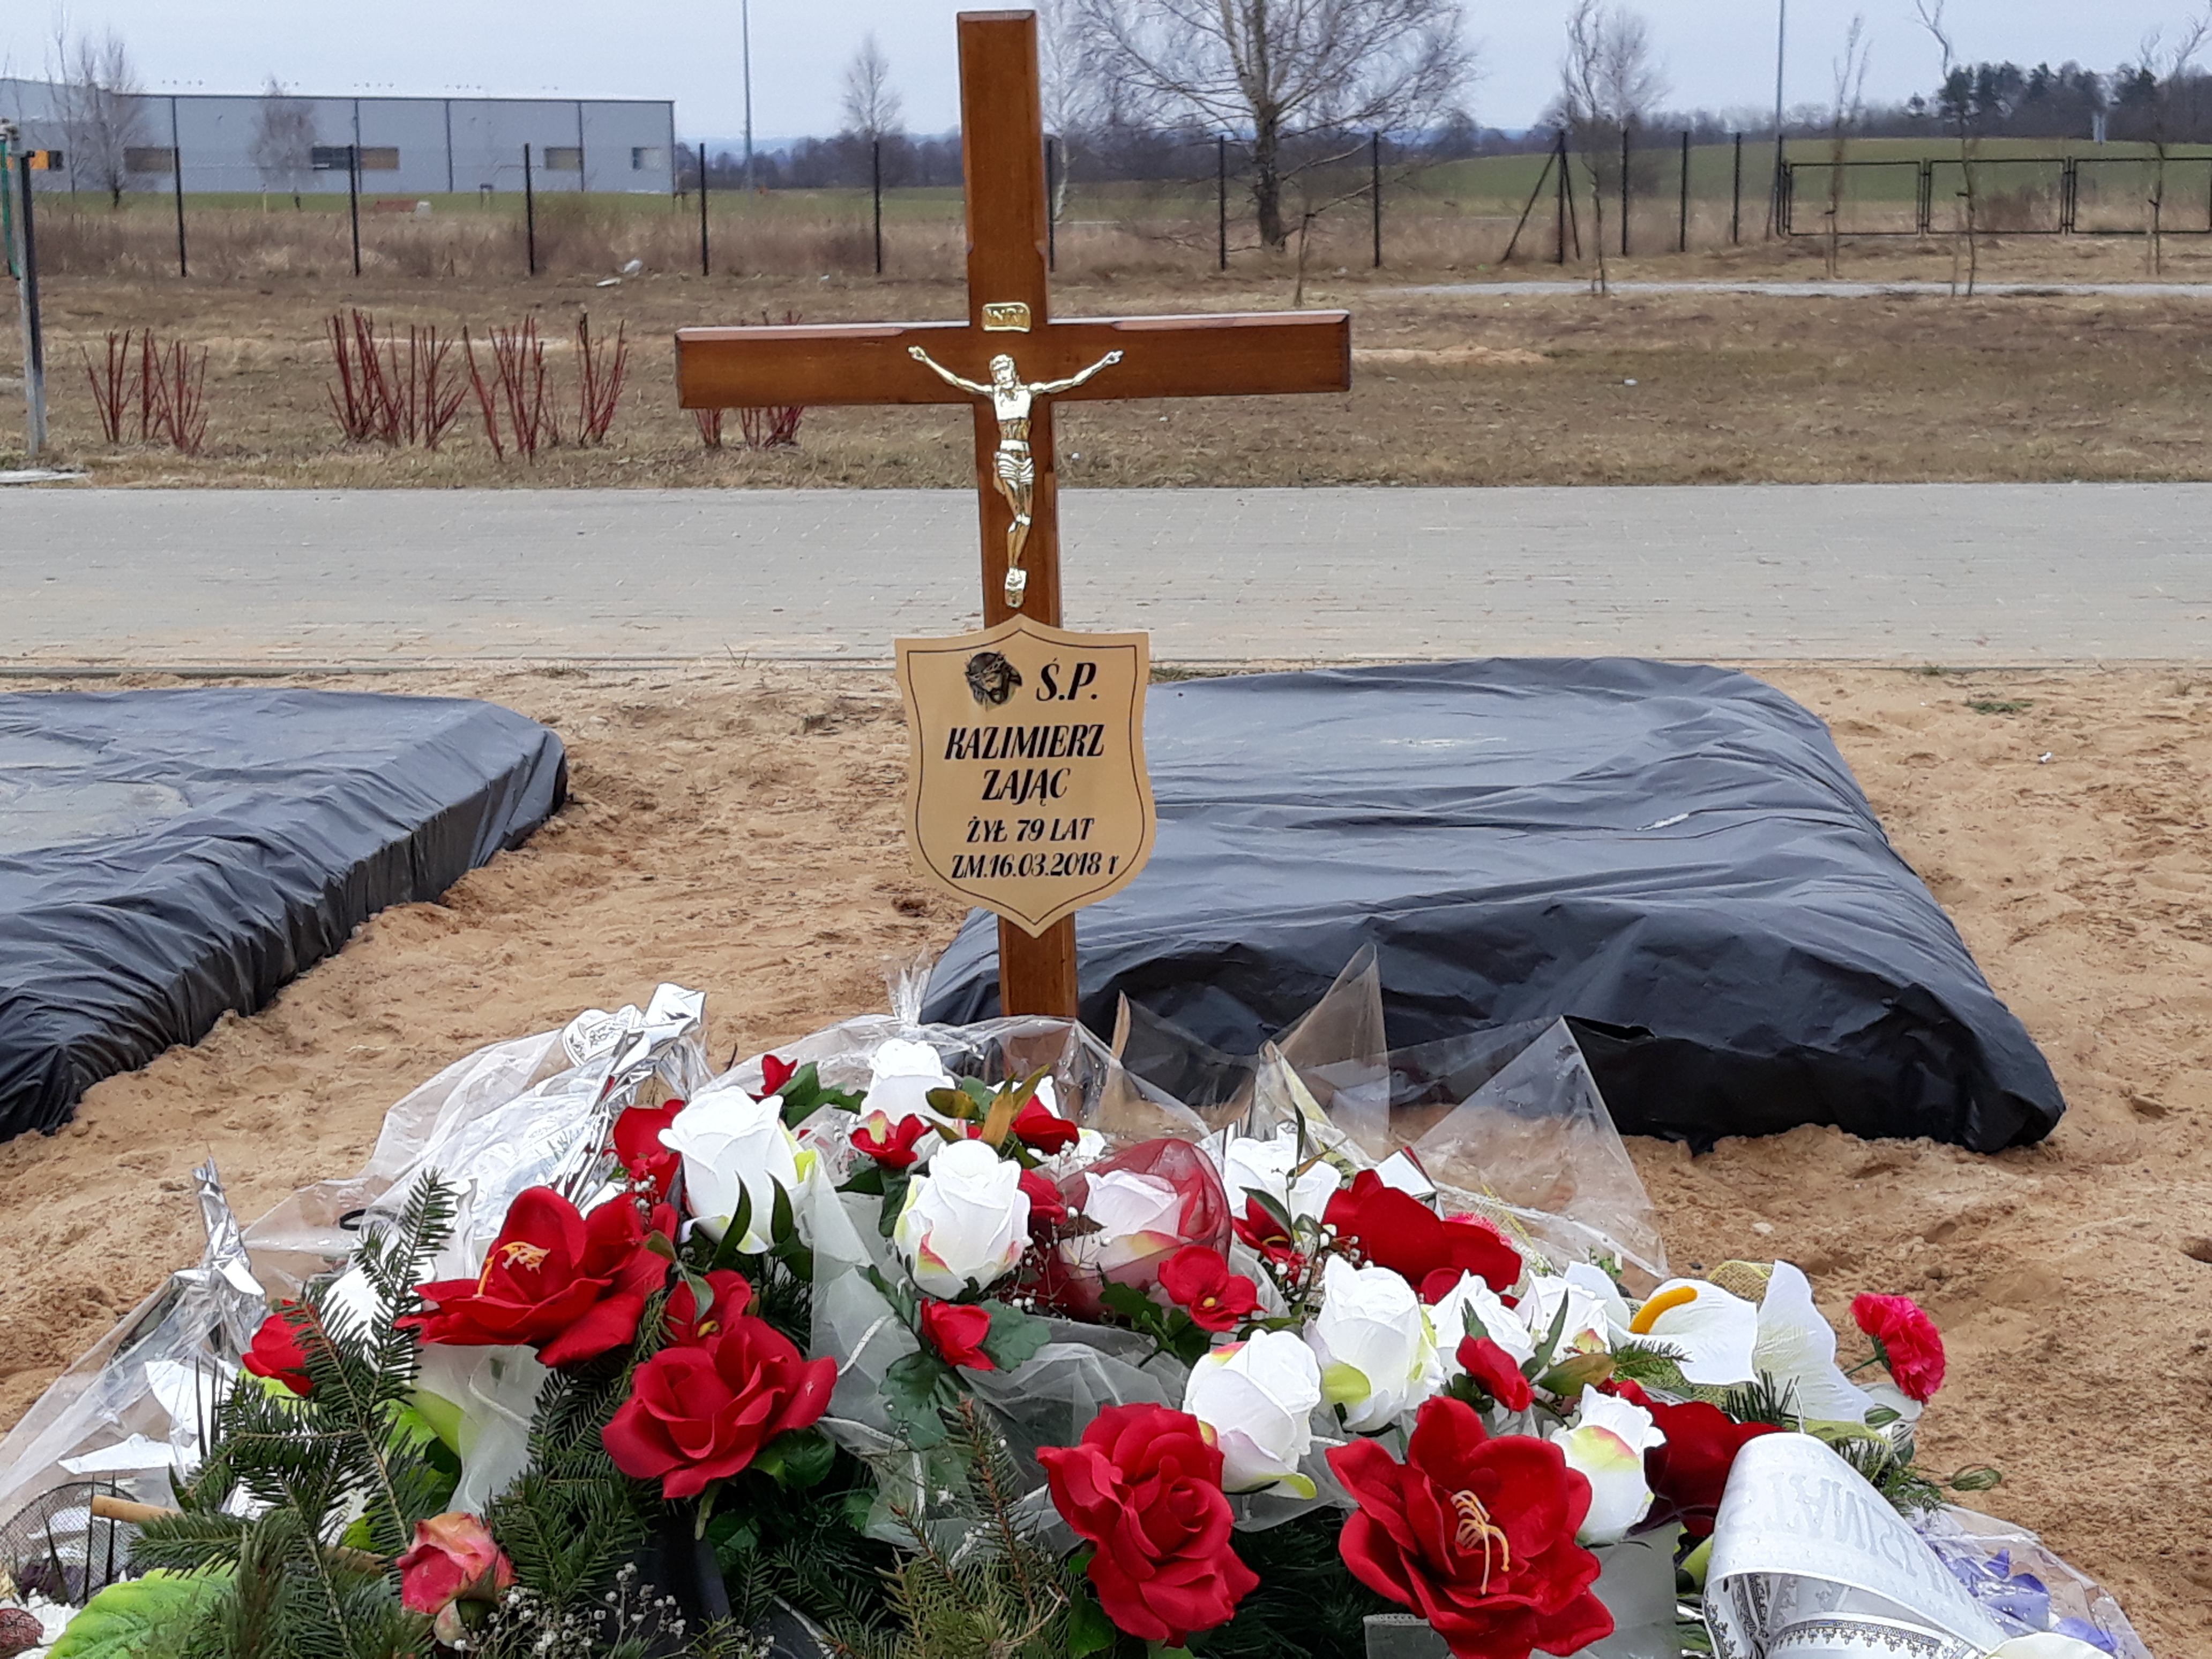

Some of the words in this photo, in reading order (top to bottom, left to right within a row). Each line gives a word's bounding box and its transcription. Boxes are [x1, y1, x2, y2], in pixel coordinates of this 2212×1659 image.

[944, 724, 1105, 760] KAZIMIERZ
[981, 768, 1072, 808] ZAJĄC
[966, 816, 1008, 843] ŻYŁ
[1017, 818, 1045, 842] 79
[1049, 817, 1095, 842] LAT
